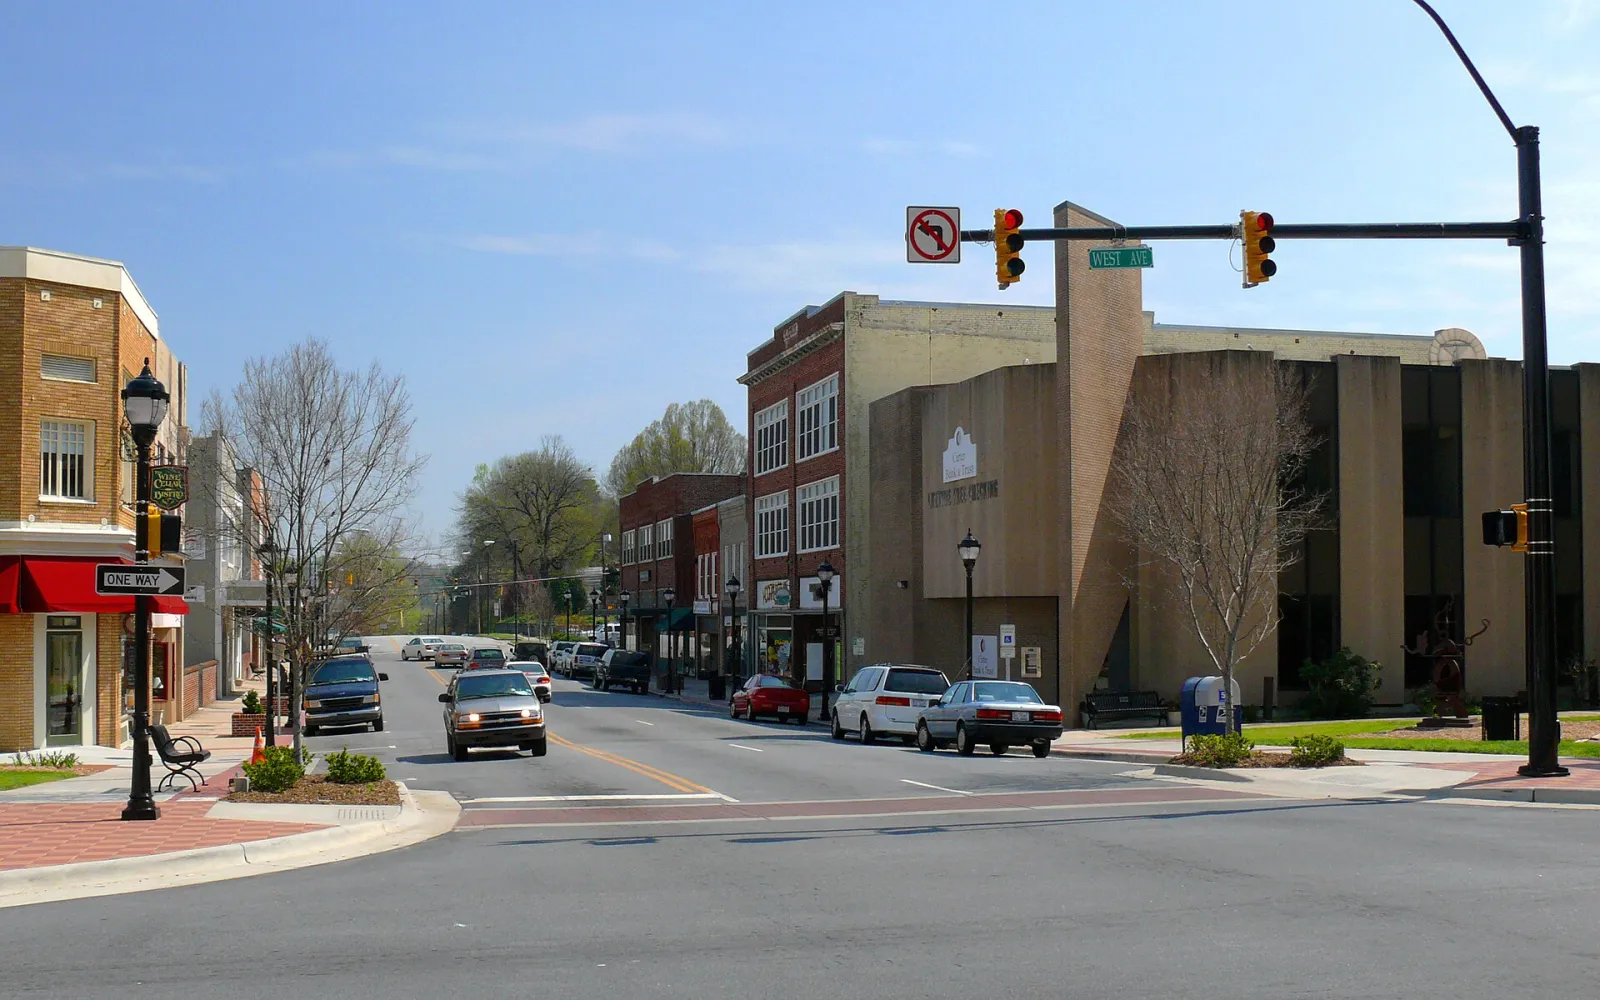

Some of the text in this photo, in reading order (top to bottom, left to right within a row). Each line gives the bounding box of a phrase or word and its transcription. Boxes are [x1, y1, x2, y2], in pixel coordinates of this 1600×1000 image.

[1092, 250, 1148, 267] WEST AVE
[158, 473, 181, 481] WINE
[154, 491, 184, 500] BISTRO
[107, 574, 160, 586] ONE WAY
